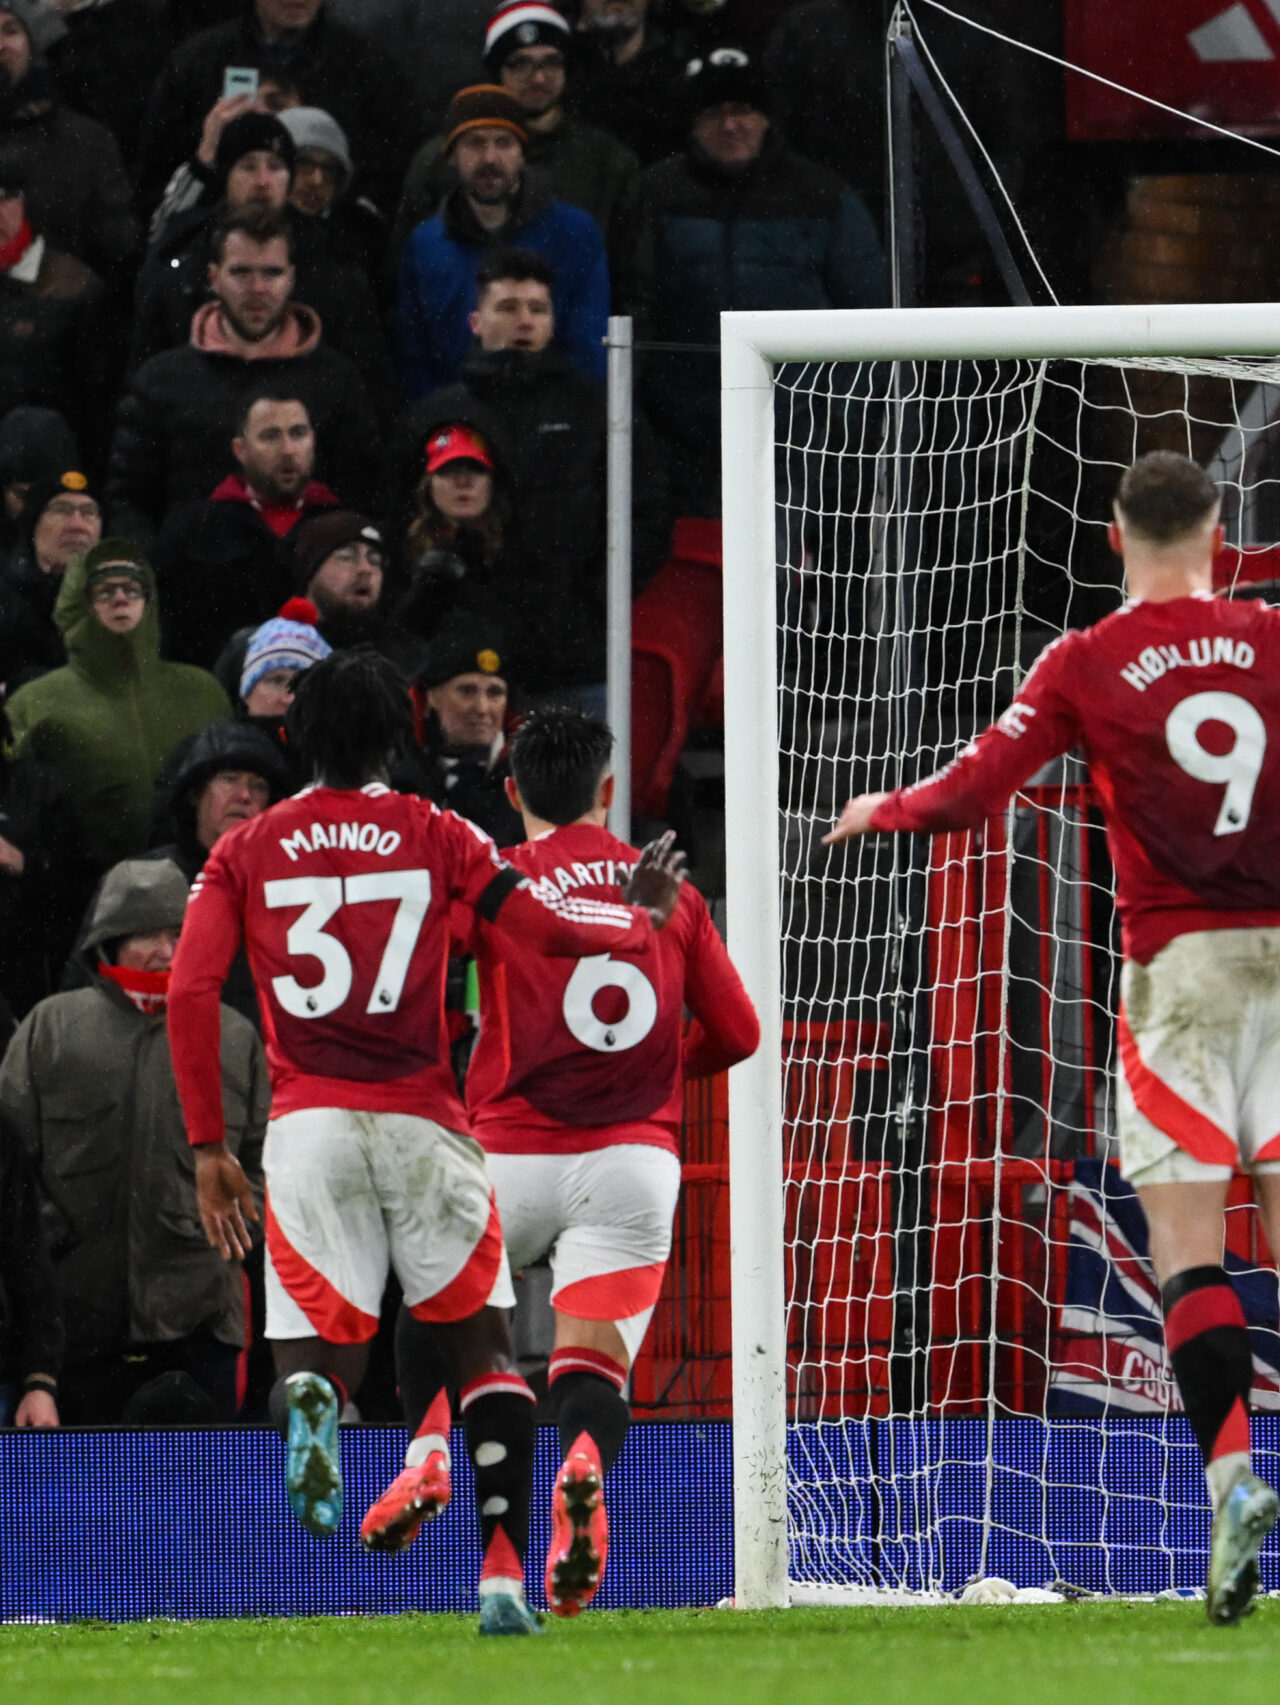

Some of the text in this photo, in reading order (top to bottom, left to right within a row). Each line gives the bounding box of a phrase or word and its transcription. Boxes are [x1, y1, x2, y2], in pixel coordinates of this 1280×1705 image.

[1119, 636, 1256, 692] HØJLUND
[1165, 690, 1268, 837] 9
[279, 821, 402, 862] MAINOO
[263, 868, 433, 1020] 37
[562, 951, 659, 1053] 6
